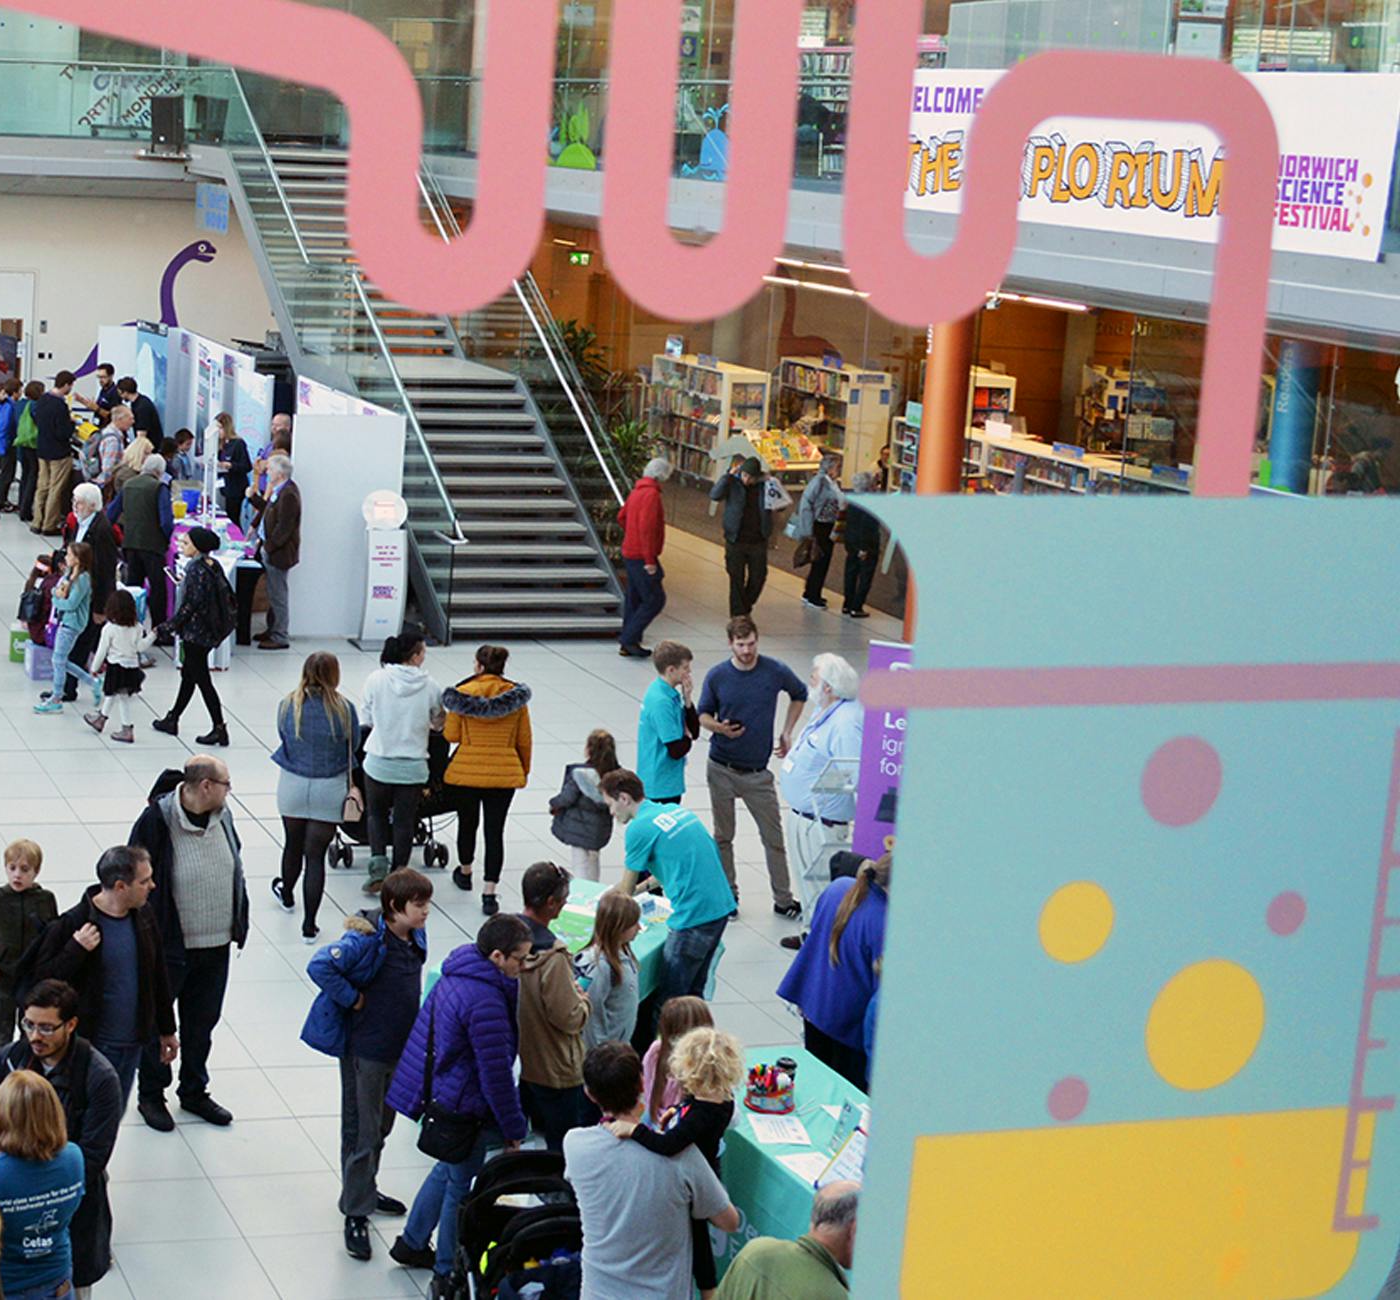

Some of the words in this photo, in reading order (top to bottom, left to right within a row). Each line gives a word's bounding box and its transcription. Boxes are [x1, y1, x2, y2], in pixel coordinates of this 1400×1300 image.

[912, 86, 984, 114] ELCOME
[903, 130, 964, 197] THE
[1021, 132, 1226, 218] PLORIUM
